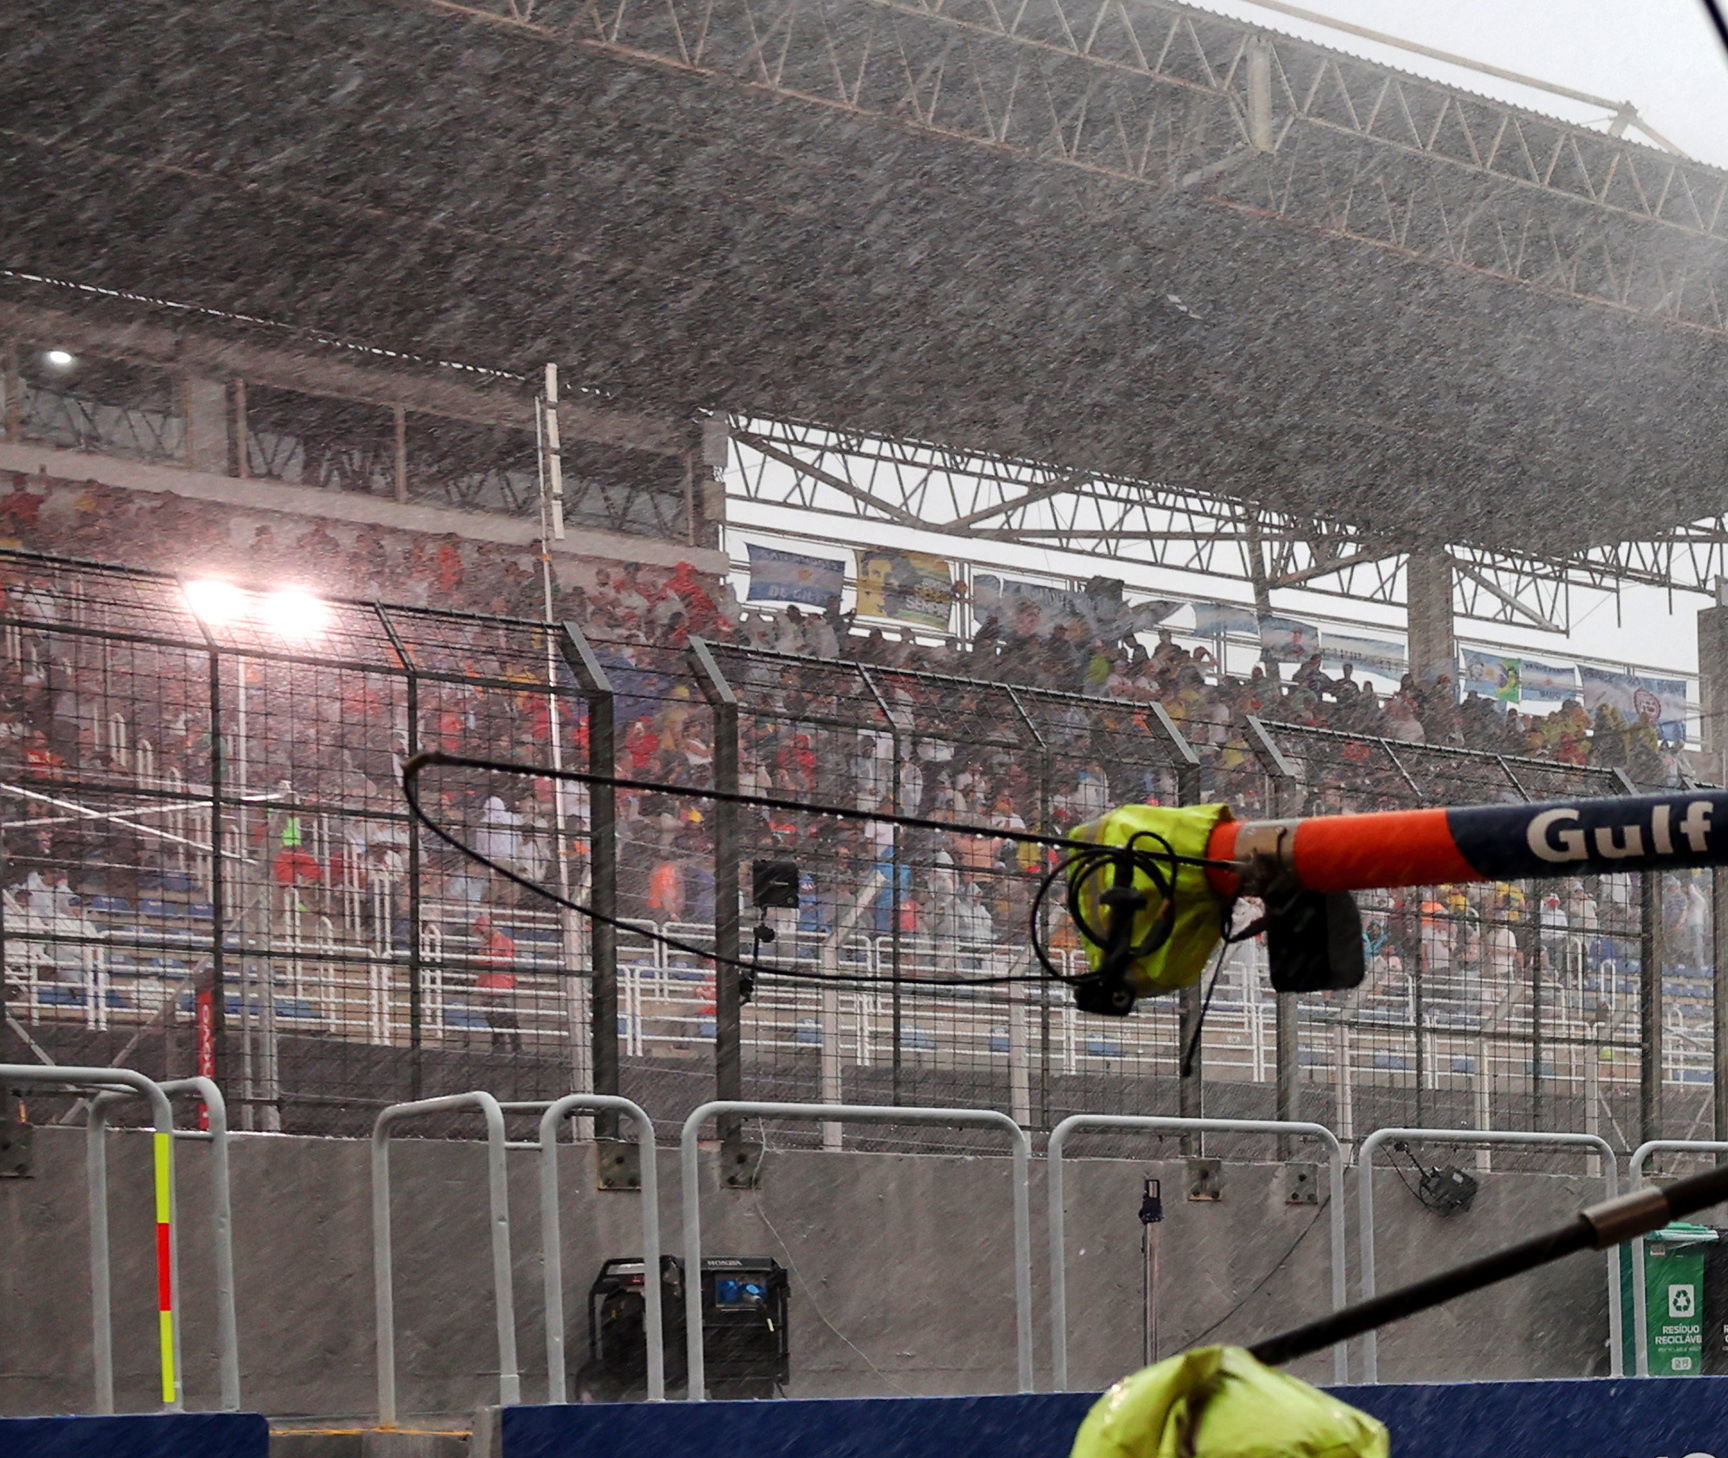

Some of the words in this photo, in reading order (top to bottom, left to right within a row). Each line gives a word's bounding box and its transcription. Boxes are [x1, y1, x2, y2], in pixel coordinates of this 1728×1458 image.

[1526, 800, 1714, 863] Gulf
[1662, 1322, 1700, 1335] RESÍDUO
[1655, 1335, 1702, 1345] RECICLÁVE
